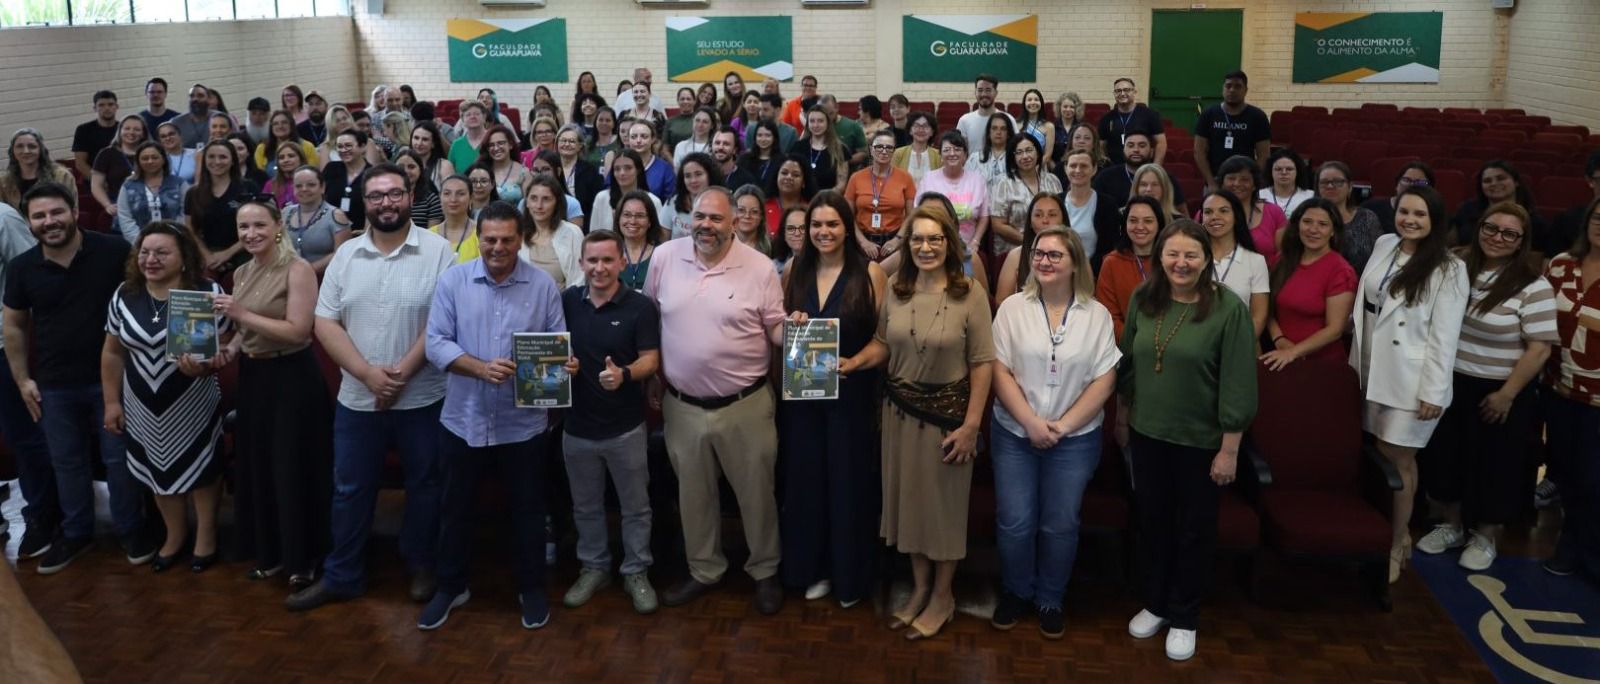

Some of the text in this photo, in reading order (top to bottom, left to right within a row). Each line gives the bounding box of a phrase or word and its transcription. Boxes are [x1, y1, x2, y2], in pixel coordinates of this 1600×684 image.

[696, 40, 745, 48] SEU ESTUDO
[1327, 38, 1405, 46] CONHECIMENTO
[1406, 37, 1412, 46] É
[696, 48, 728, 56] LEVADO
[728, 48, 736, 56] A
[1316, 47, 1326, 55] O
[1326, 47, 1373, 55] ALIMENTO
[1374, 47, 1388, 55] DA
[1212, 121, 1248, 130] MILANO
